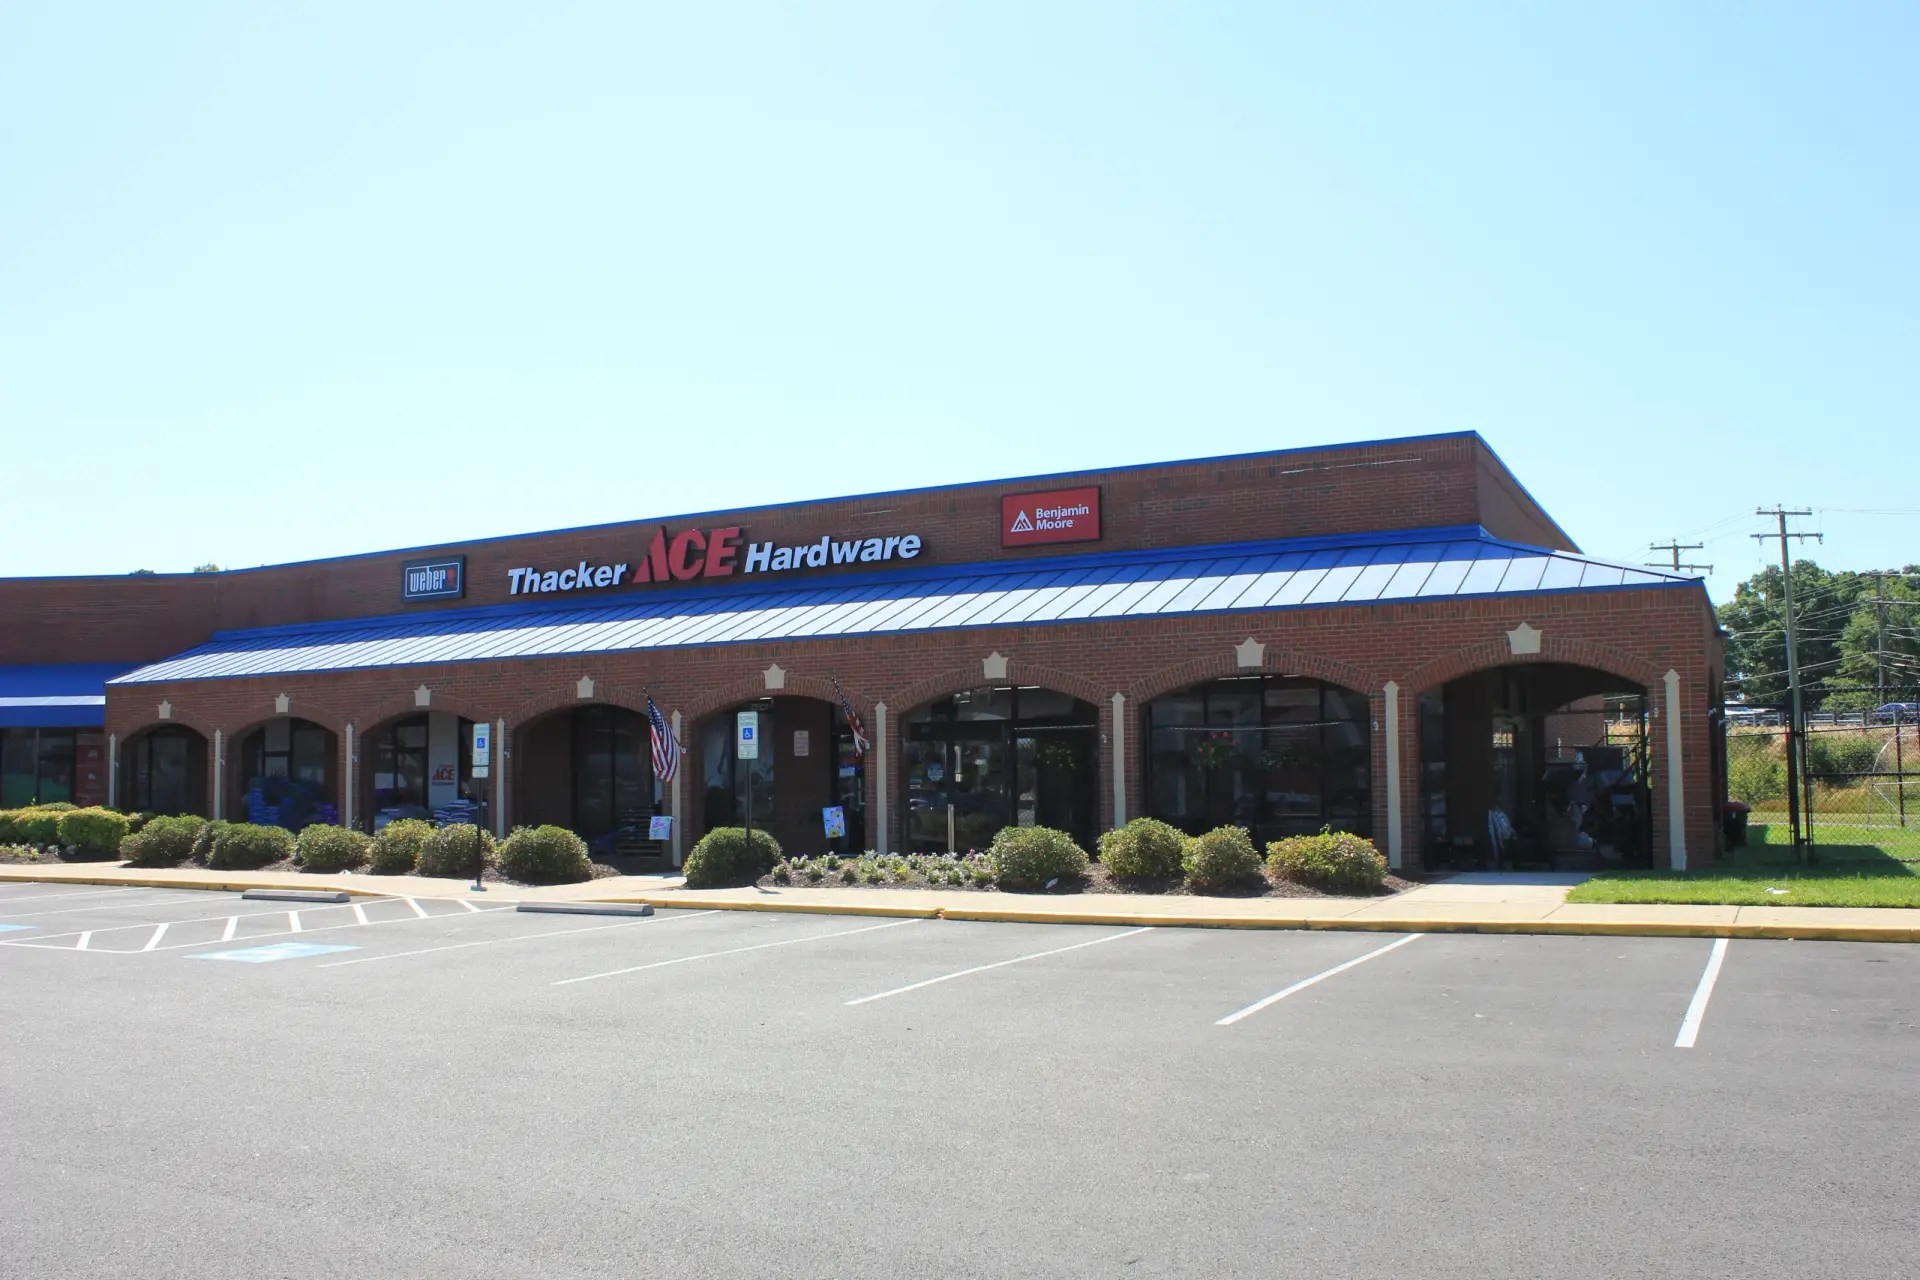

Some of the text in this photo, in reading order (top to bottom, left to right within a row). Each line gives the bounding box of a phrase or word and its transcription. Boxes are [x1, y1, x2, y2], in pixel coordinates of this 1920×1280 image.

[1036, 504, 1089, 520] Benjamin
[1036, 519, 1073, 530] Moore
[508, 526, 921, 595] Thacker ACE Hardware
[409, 566, 446, 592] weber
[432, 767, 456, 781] ACE
